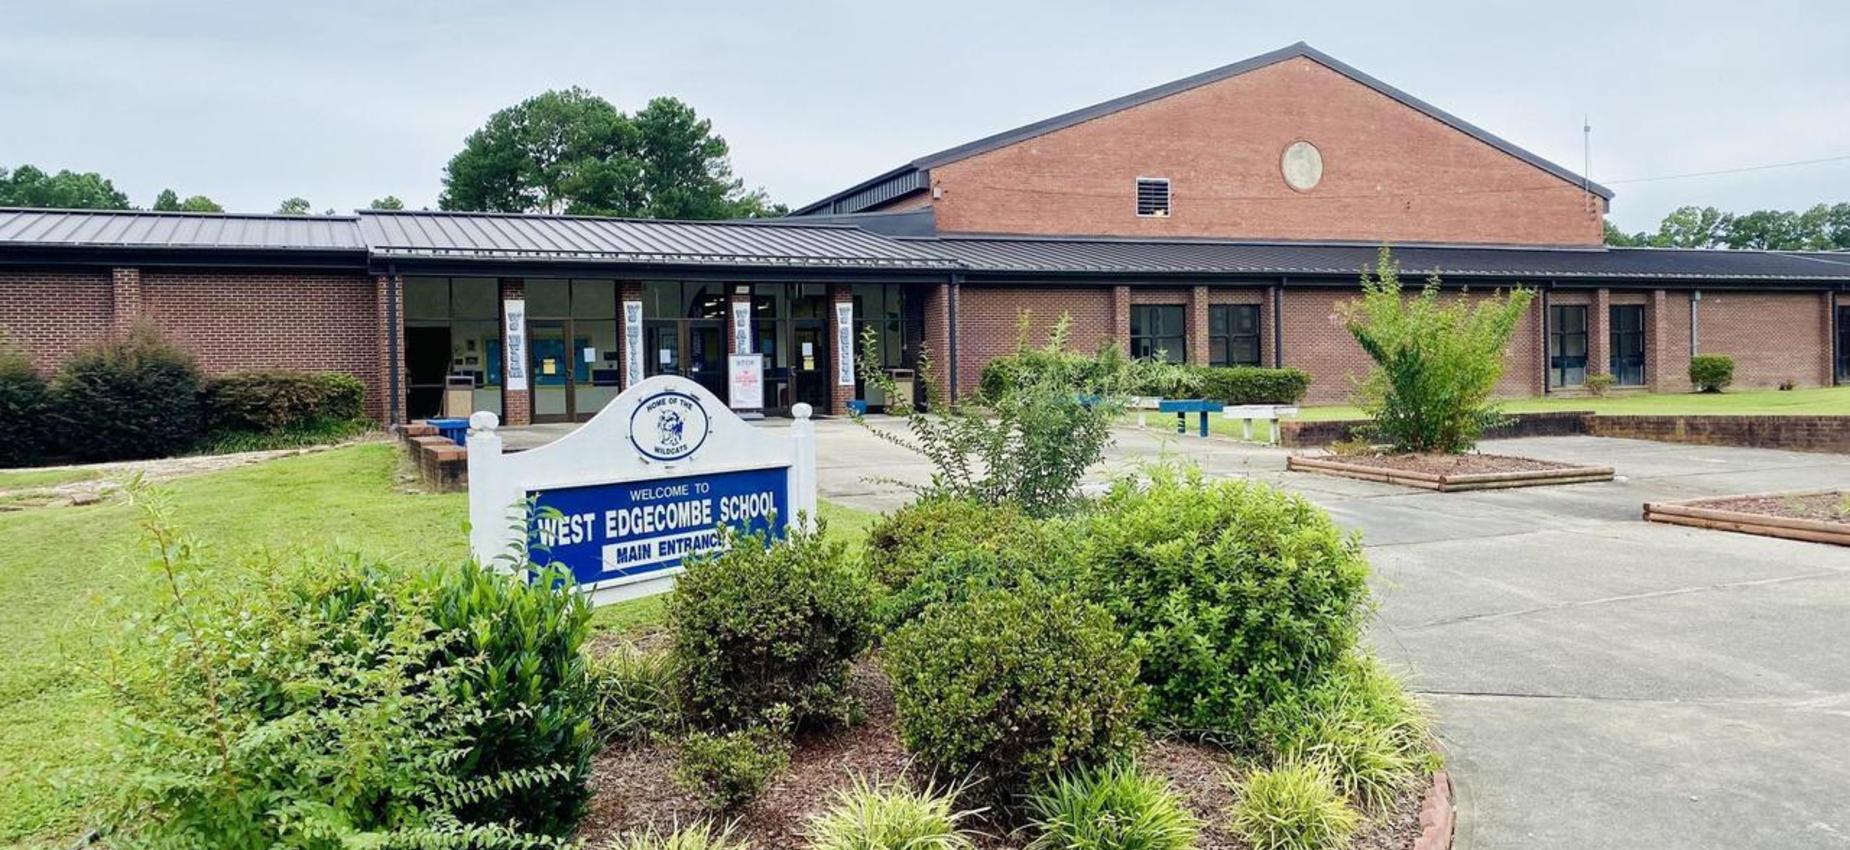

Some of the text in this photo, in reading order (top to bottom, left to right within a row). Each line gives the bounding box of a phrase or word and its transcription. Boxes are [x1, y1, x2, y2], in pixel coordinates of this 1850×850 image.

[646, 398, 666, 412] HOME
[680, 399, 693, 411] THE
[654, 444, 688, 455] WILDCATS
[630, 482, 709, 501] WELCOME TO
[538, 492, 777, 547] WEST EDGECOMBE SCHOOL
[617, 544, 651, 564] MAIN
